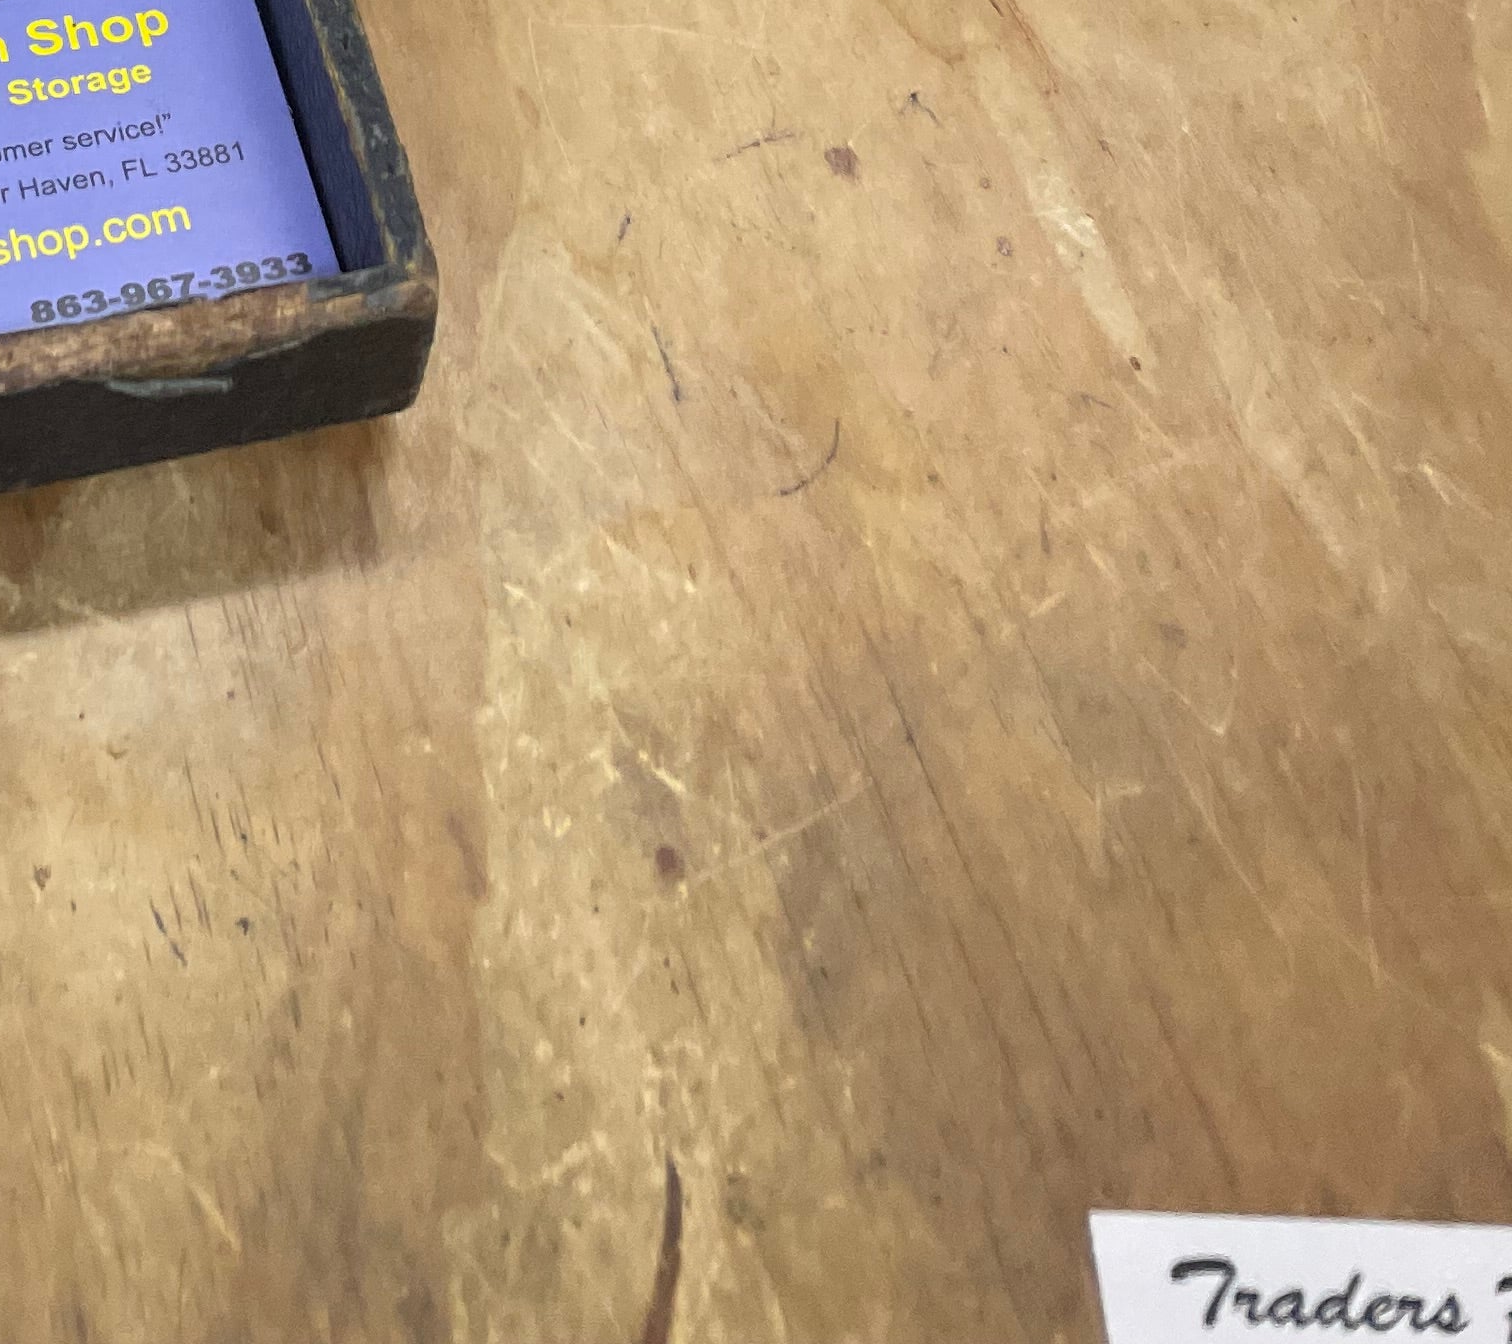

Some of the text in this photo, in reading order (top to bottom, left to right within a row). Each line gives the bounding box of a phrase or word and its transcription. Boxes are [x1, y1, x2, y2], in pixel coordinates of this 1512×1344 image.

[25, 8, 170, 57] Shop
[7, 64, 152, 109] Storage
[19, 169, 114, 201] Haven,
[121, 158, 158, 182] FL
[164, 141, 246, 174] 33881
[30, 252, 313, 324] 863-967-3933
[1170, 1257, 1472, 1333] Traders
